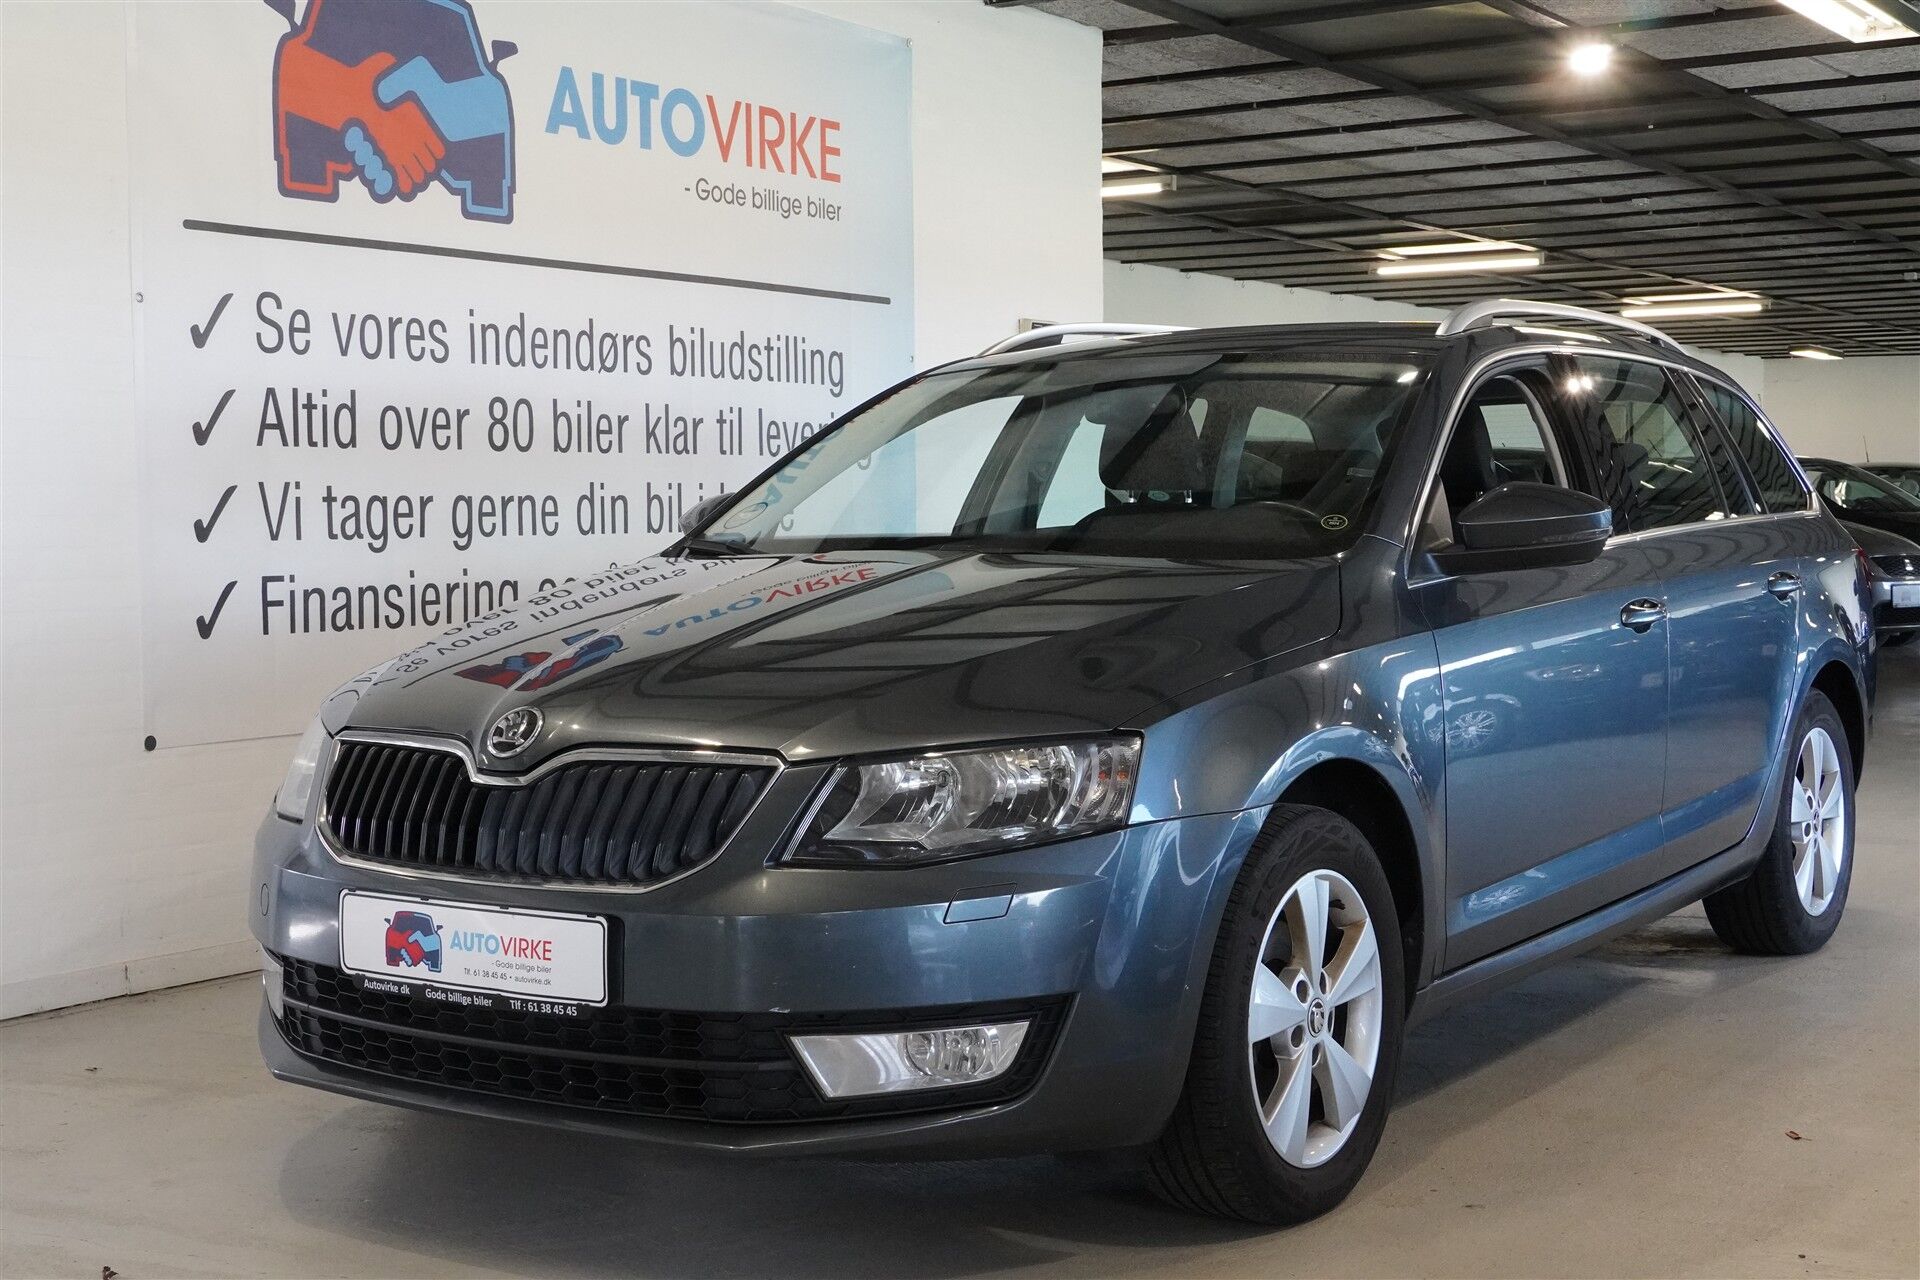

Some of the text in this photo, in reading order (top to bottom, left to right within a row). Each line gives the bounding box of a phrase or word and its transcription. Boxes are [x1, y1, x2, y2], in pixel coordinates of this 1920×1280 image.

[545, 66, 843, 184] AUTOVIRKE
[695, 178, 747, 207] Gode
[752, 187, 802, 219] billige
[807, 196, 842, 222] biler
[256, 291, 844, 398] Se vores indendørs biludstilling
[256, 387, 357, 450] Altid
[379, 404, 471, 451] over
[487, 396, 534, 453] 80
[552, 398, 630, 455] biler
[644, 402, 704, 456] klar
[716, 406, 743, 456] til
[258, 480, 683, 554] Vi tager gerne din bil
[449, 930, 552, 961] AUTOVIRKE
[473, 969, 481, 977] 61
[482, 970, 490, 978] 38
[491, 971, 499, 979] 45
[500, 972, 508, 980] 45
[495, 960, 514, 969] Gode
[515, 961, 536, 973] billige
[537, 965, 552, 974] biler
[364, 978, 399, 993] Autovirke
[425, 988, 493, 1007] Gode billige biler
[528, 1001, 539, 1012] 61
[541, 1002, 551, 1014] 38
[553, 1003, 564, 1015] 45
[565, 1004, 577, 1016] 45
